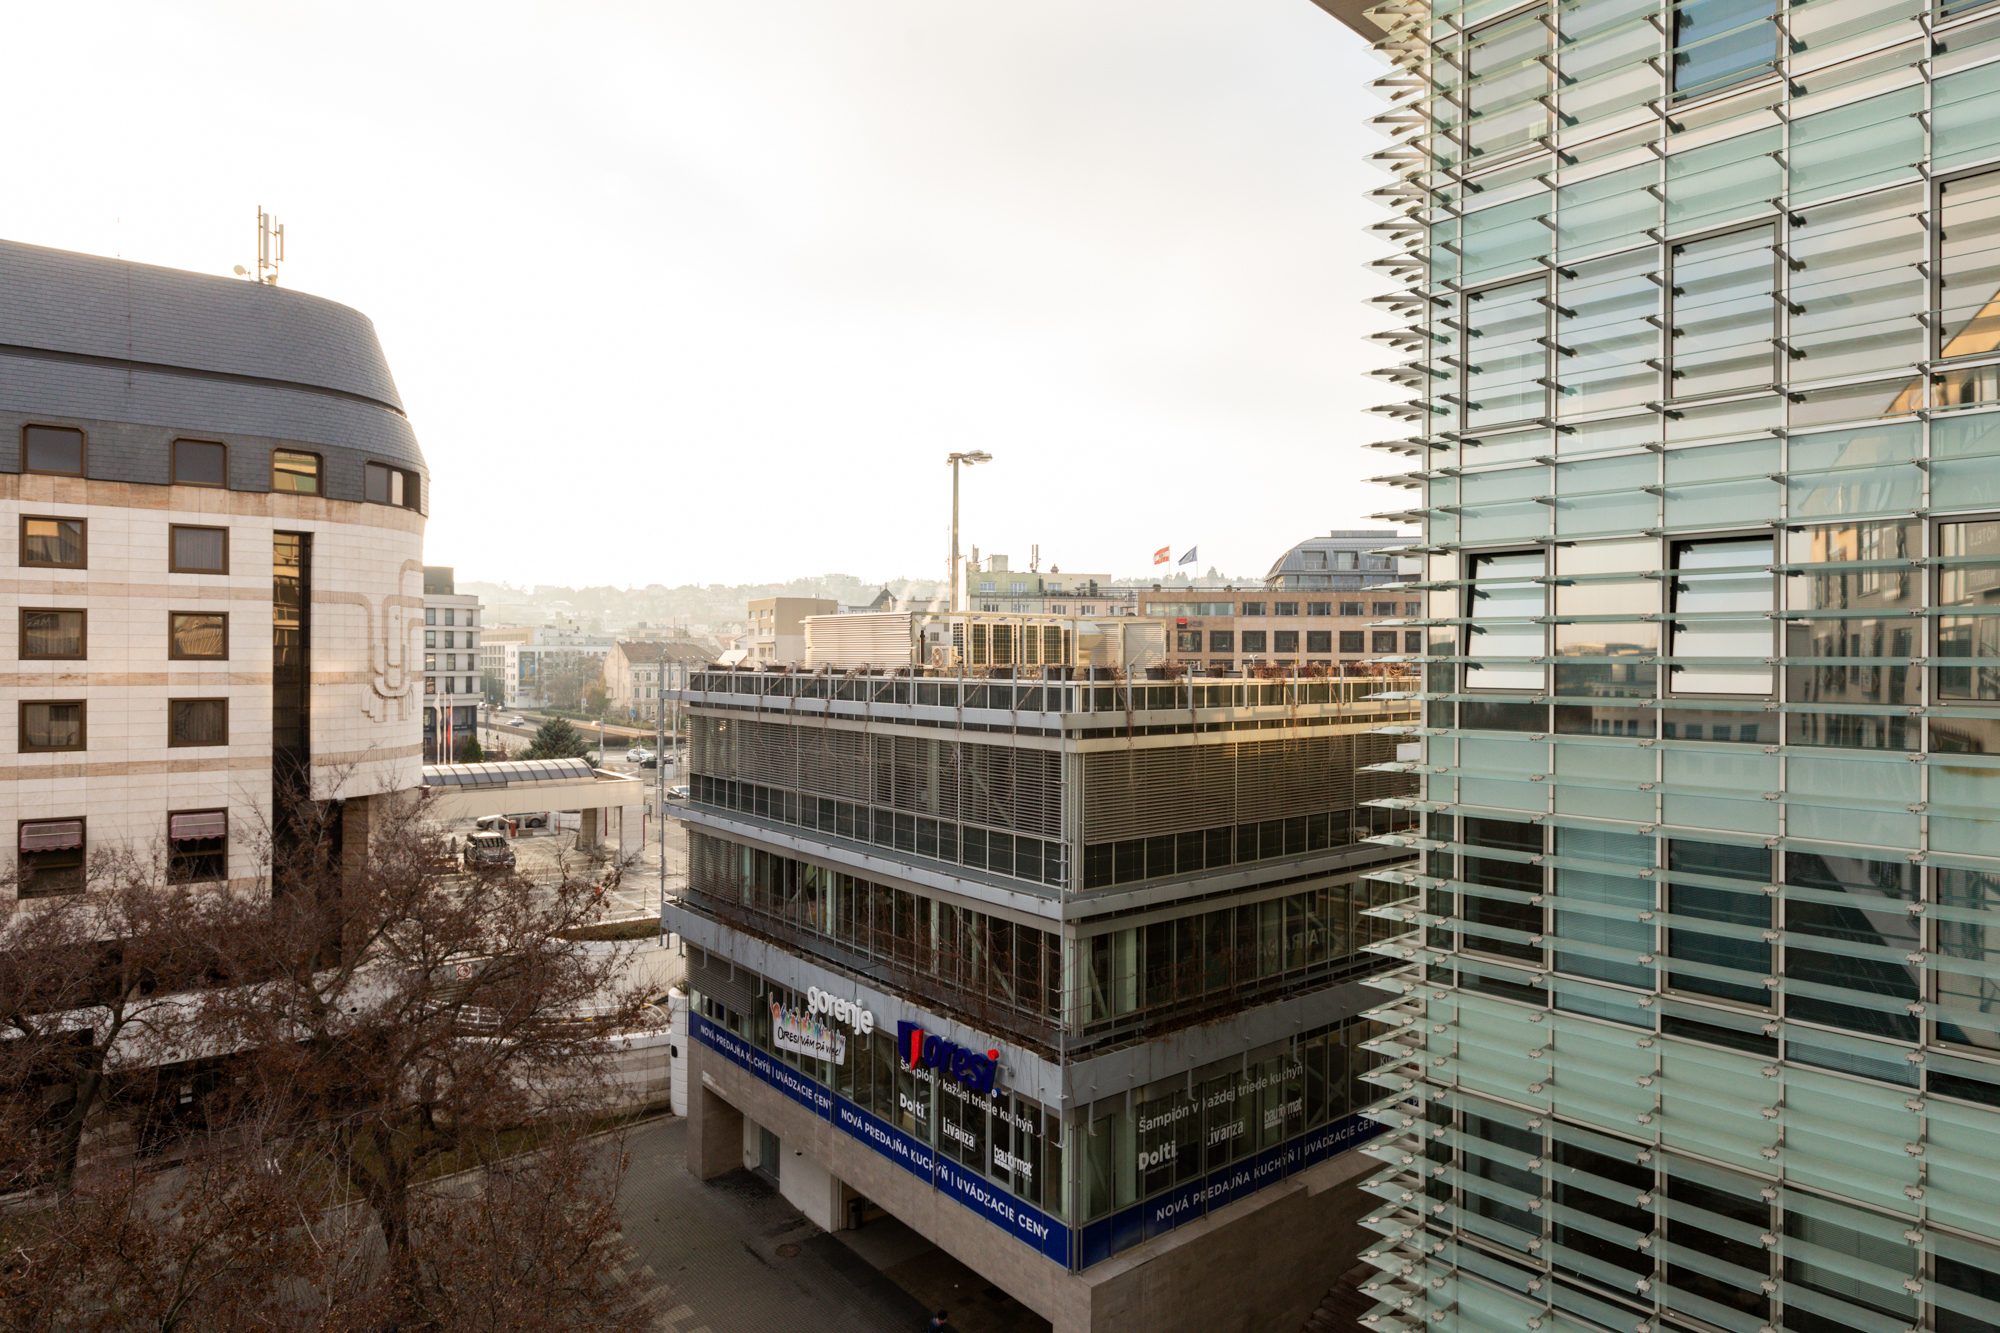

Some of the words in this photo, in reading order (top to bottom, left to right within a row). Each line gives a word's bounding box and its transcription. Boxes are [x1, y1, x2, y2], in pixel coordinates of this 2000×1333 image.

[807, 985, 874, 1036] gorenje
[746, 1052, 771, 1075] KCHÝŇ
[776, 1069, 813, 1100] UVÁDZACIE
[899, 1093, 924, 1120] Dolti
[971, 1093, 998, 1117] triede
[1138, 1105, 1189, 1134] Šampión
[1192, 1102, 1199, 1113] v
[1238, 1077, 1268, 1097] triede
[1264, 1096, 1303, 1121] baufomat
[942, 1117, 975, 1147] Livanza
[1207, 1120, 1244, 1147] ivanza
[1138, 1140, 1176, 1171] Dolti
[841, 1108, 863, 1130] NOVÁ
[865, 1122, 909, 1158] PREDAJŇA
[911, 1149, 948, 1181] KUCHÝŇ
[957, 1176, 1015, 1222] UVÁDZACIE
[1018, 1214, 1049, 1240] CENY
[1156, 1194, 1189, 1222] NOVÁ
[1193, 1171, 1251, 1203] PREDAJŇA
[1254, 1148, 1295, 1179] KUCHÝŇ
[1304, 1126, 1355, 1156] UVÁDZACIE
